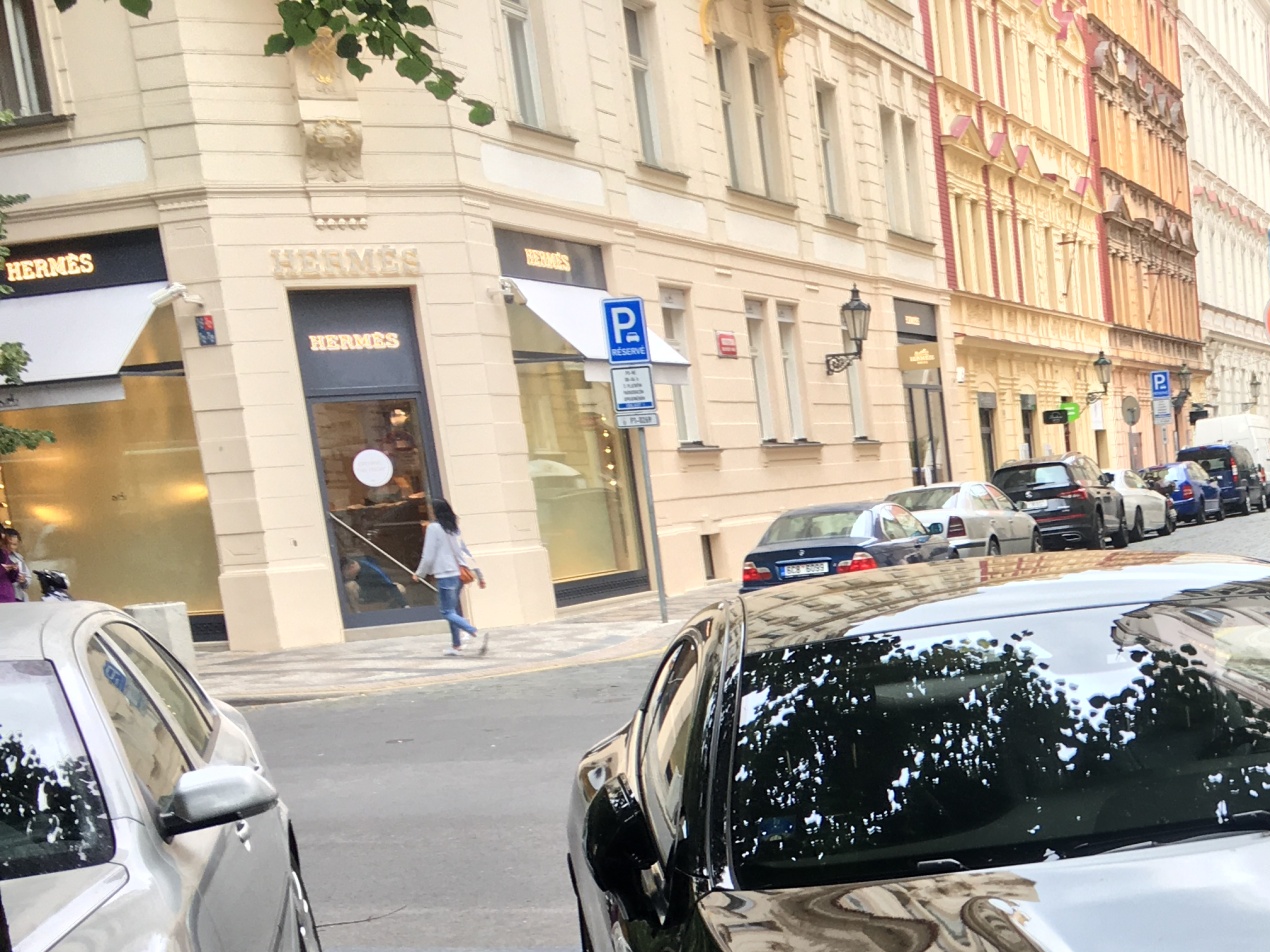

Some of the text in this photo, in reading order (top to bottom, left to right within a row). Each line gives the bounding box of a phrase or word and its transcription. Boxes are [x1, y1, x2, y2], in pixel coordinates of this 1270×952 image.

[6, 253, 95, 281] HERMÈS
[270, 245, 421, 277] HERMÈS
[611, 307, 636, 344] P
[308, 331, 400, 351] HERMÈS
[612, 345, 646, 356] RÉSERVÉ
